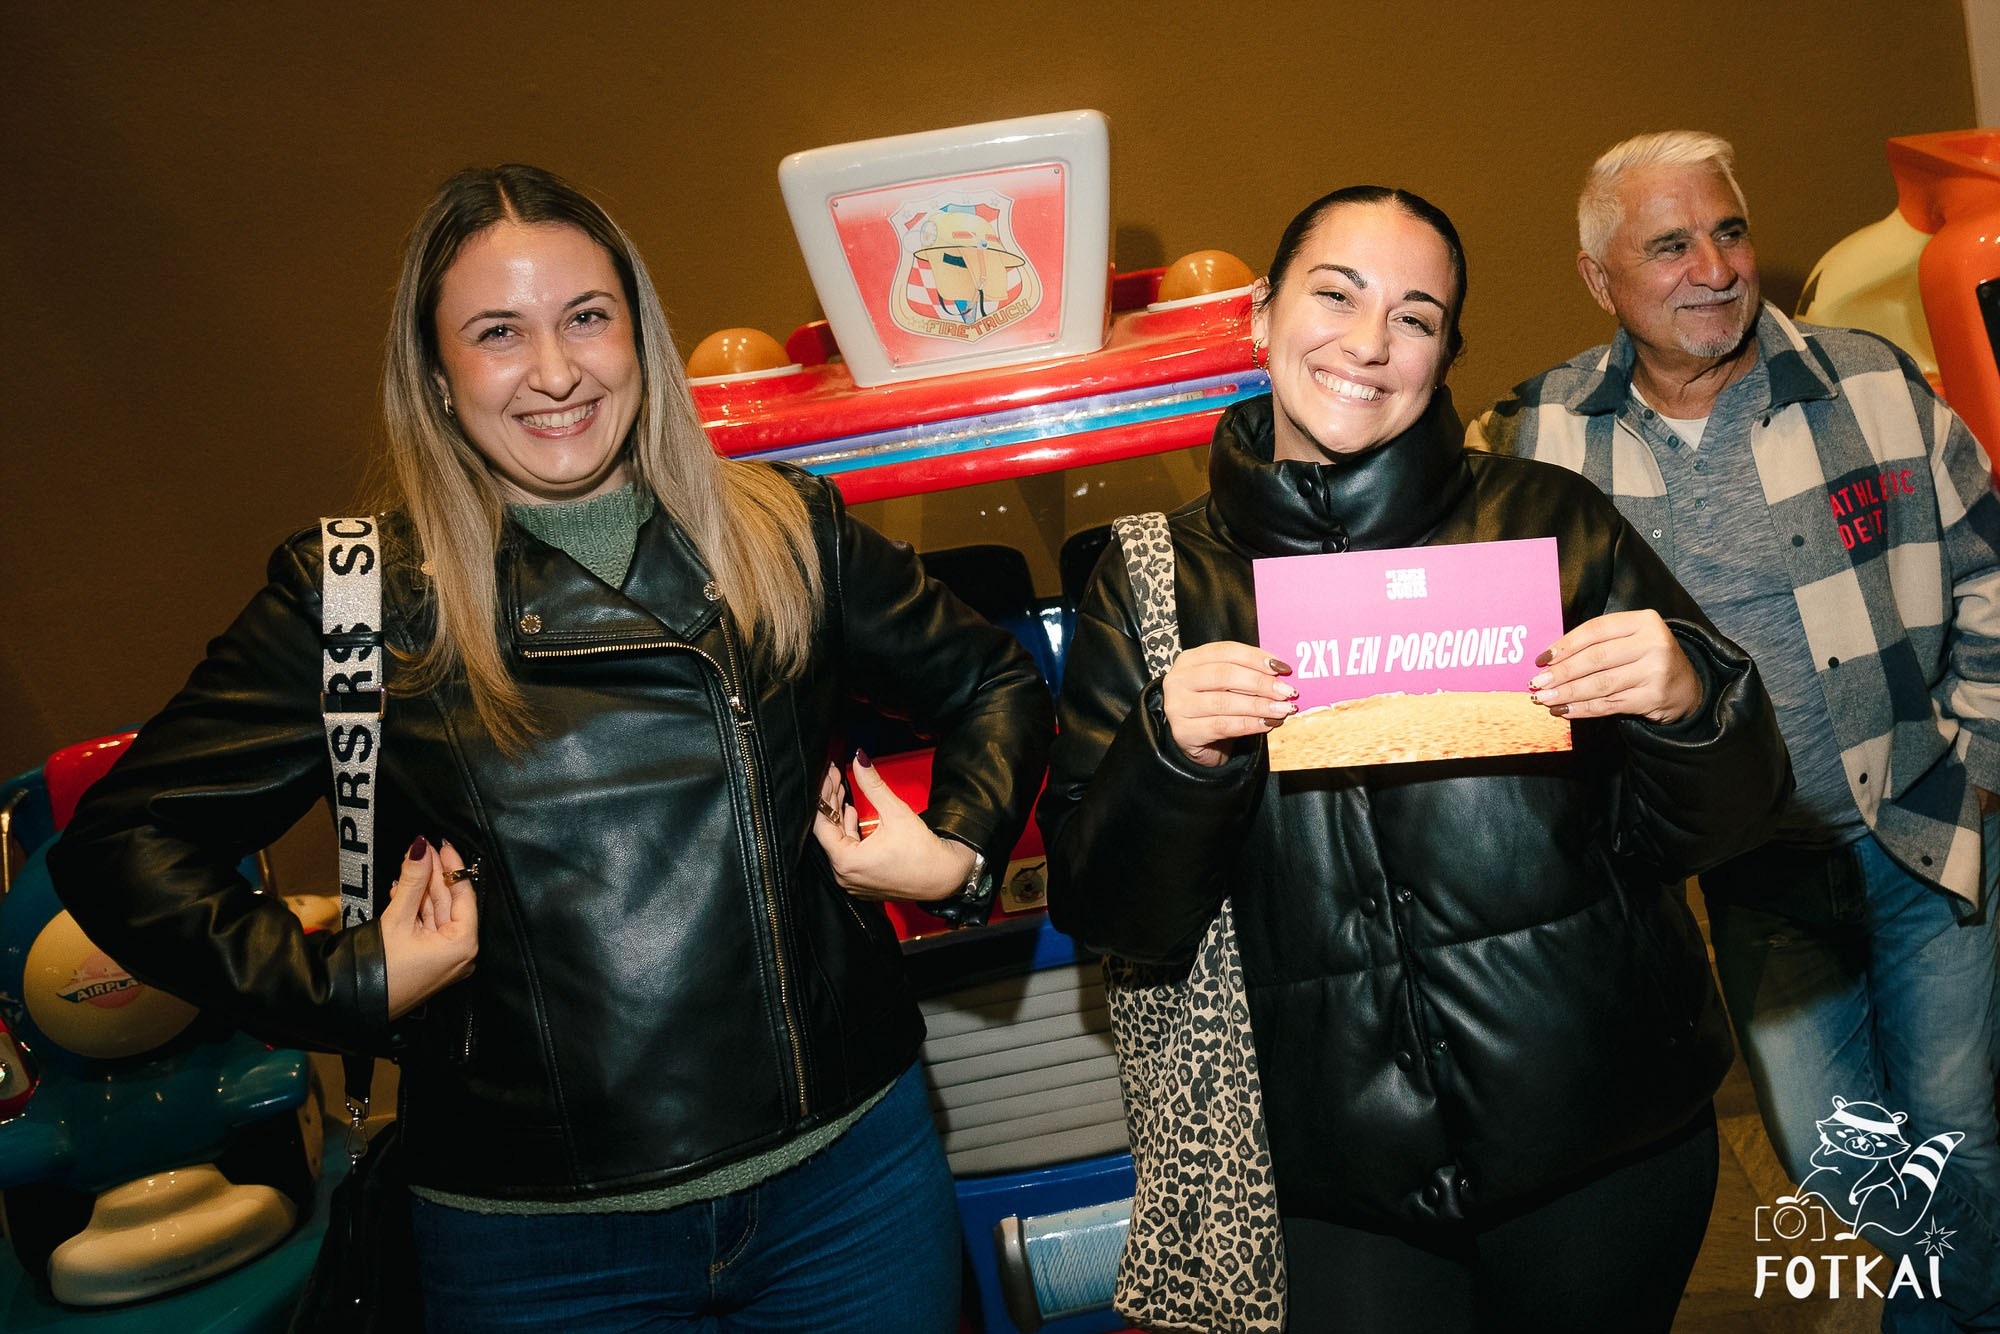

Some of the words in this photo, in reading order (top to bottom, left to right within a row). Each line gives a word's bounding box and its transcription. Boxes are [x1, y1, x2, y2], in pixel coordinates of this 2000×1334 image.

[1829, 469, 1915, 520] ATHLEIC
[1295, 638, 1342, 680] 2X1
[1346, 636, 1382, 676] EN
[1384, 624, 1528, 673] PORCIONES
[76, 978, 141, 1001] AIRPLA
